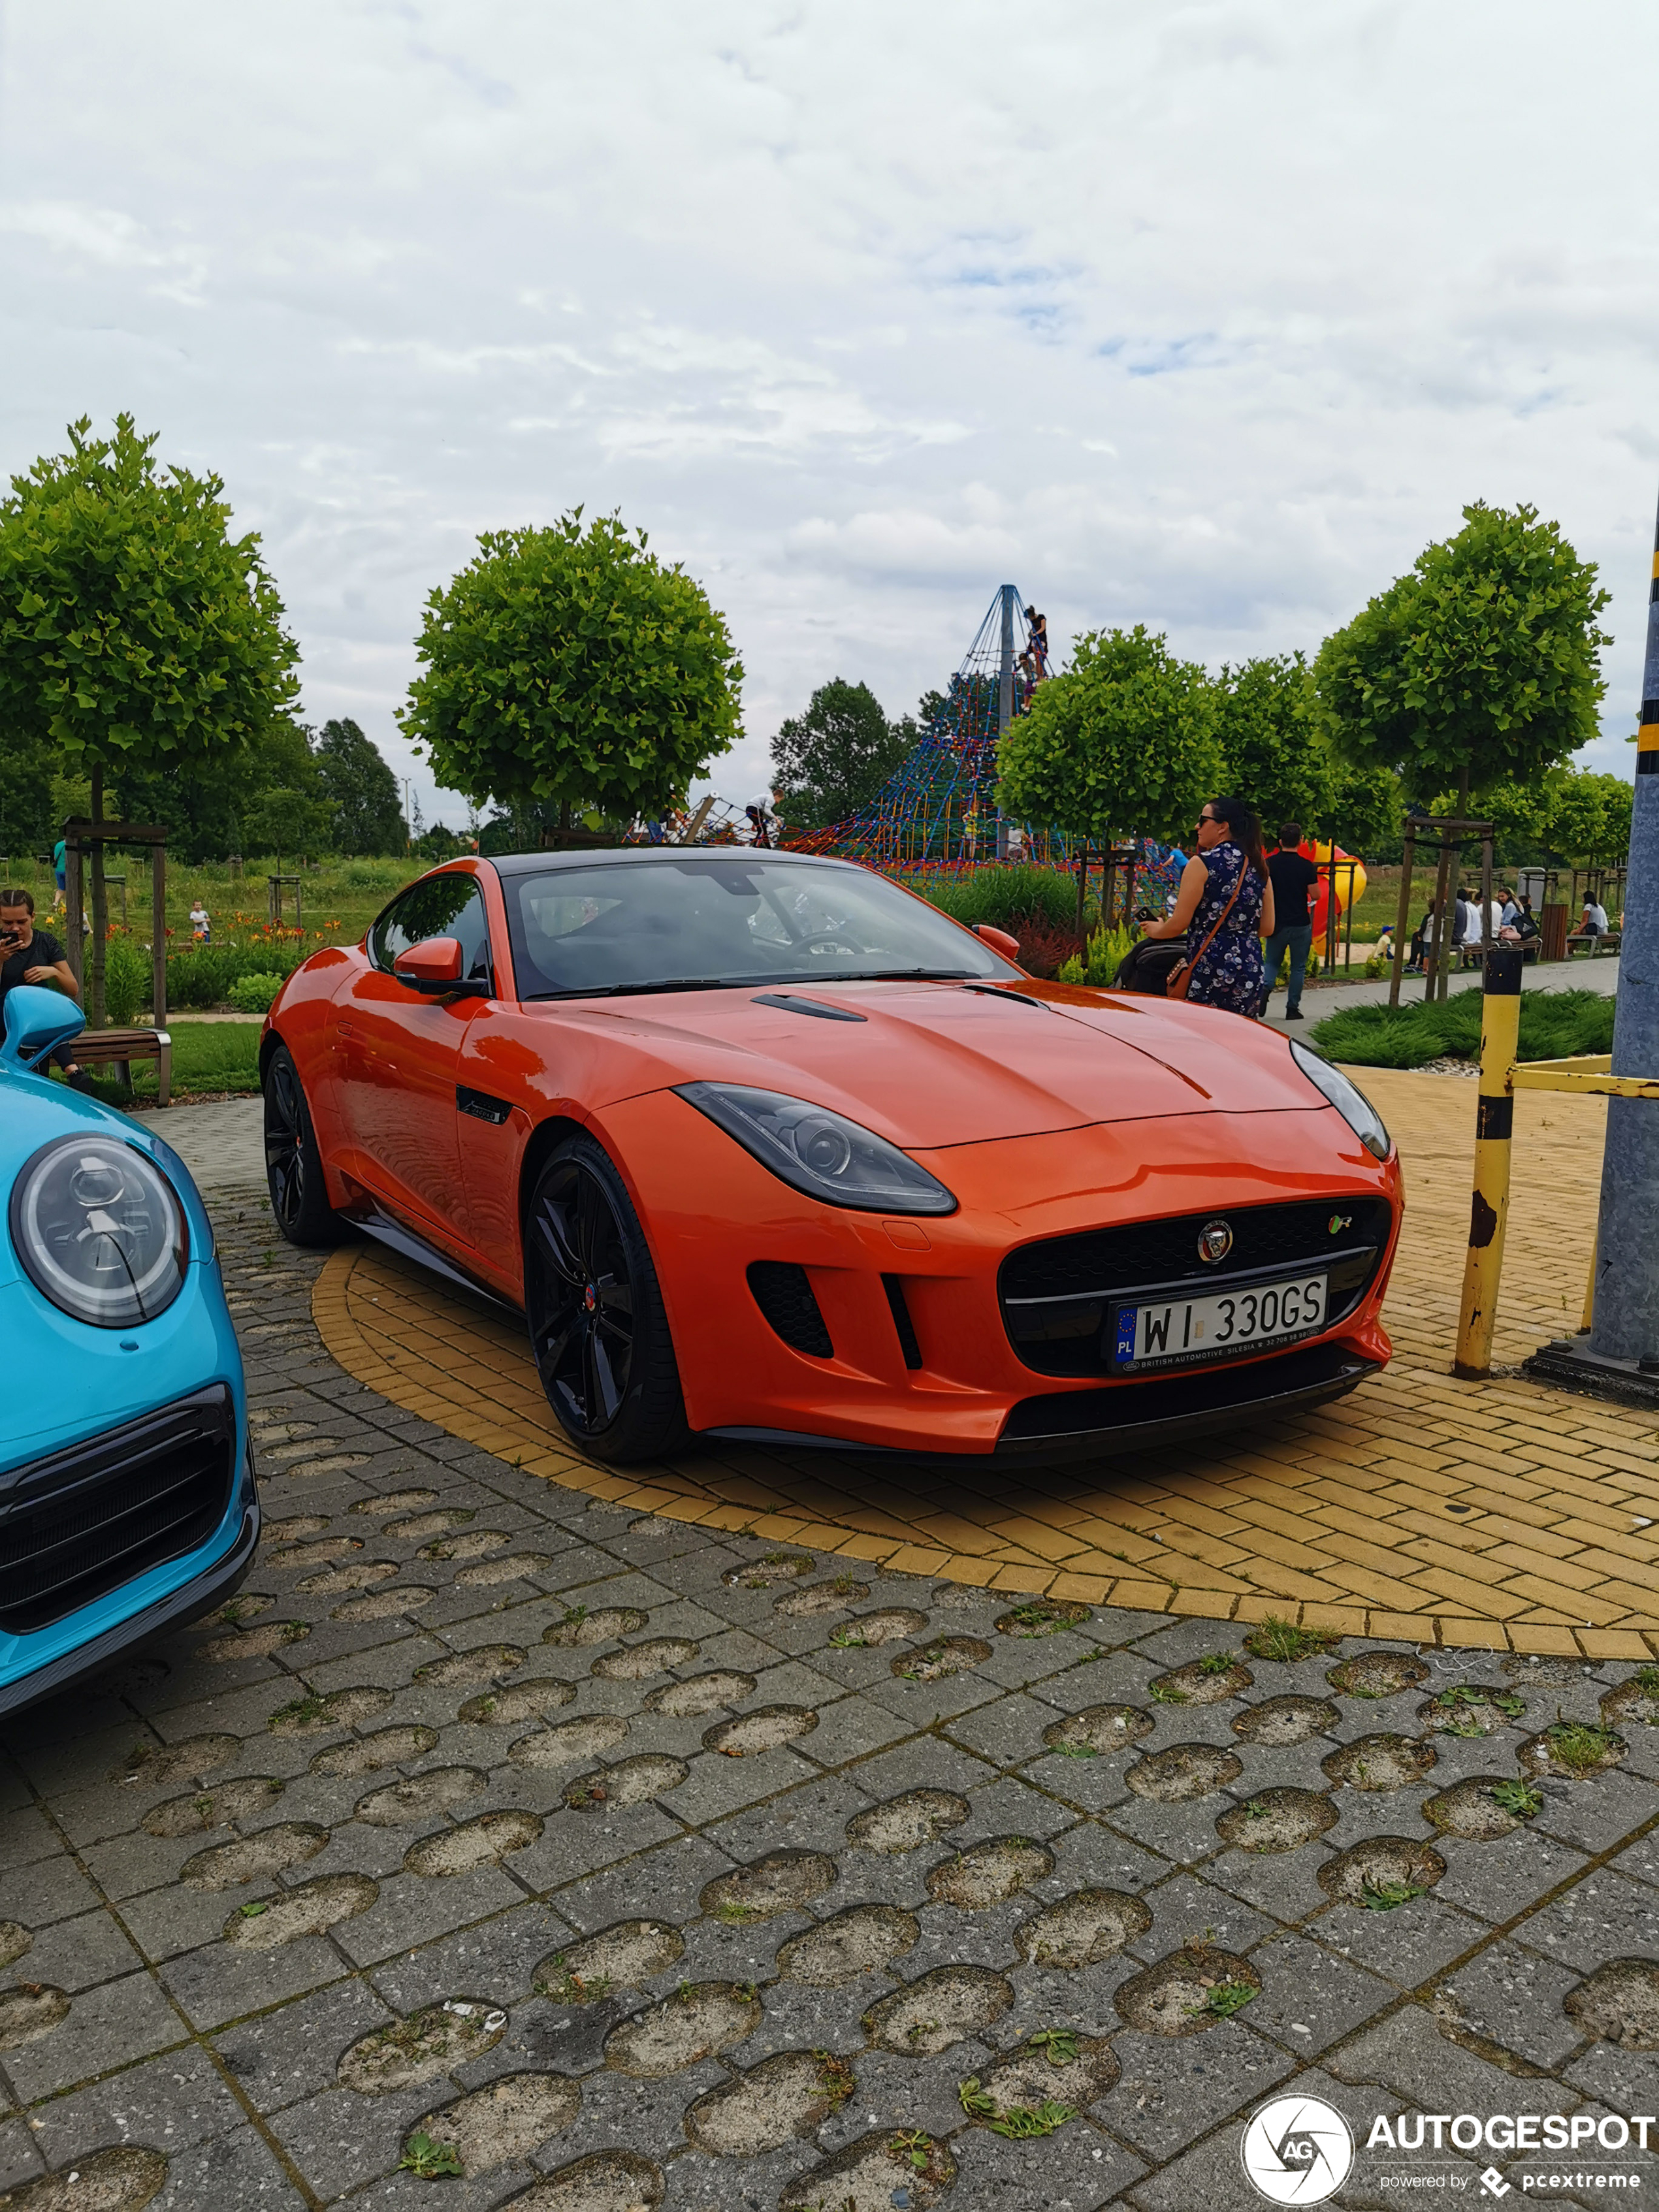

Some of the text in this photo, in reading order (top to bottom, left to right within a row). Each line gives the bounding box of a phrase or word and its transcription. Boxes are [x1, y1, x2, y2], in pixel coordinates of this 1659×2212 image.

[1144, 1281, 1321, 1354] WI 330GS
[1118, 1341, 1132, 1354] PL
[1141, 1358, 1173, 1368] BRITISH
[1175, 1349, 1223, 1363] AUTOMOTIVE
[1227, 1343, 1255, 1354] SILESIA
